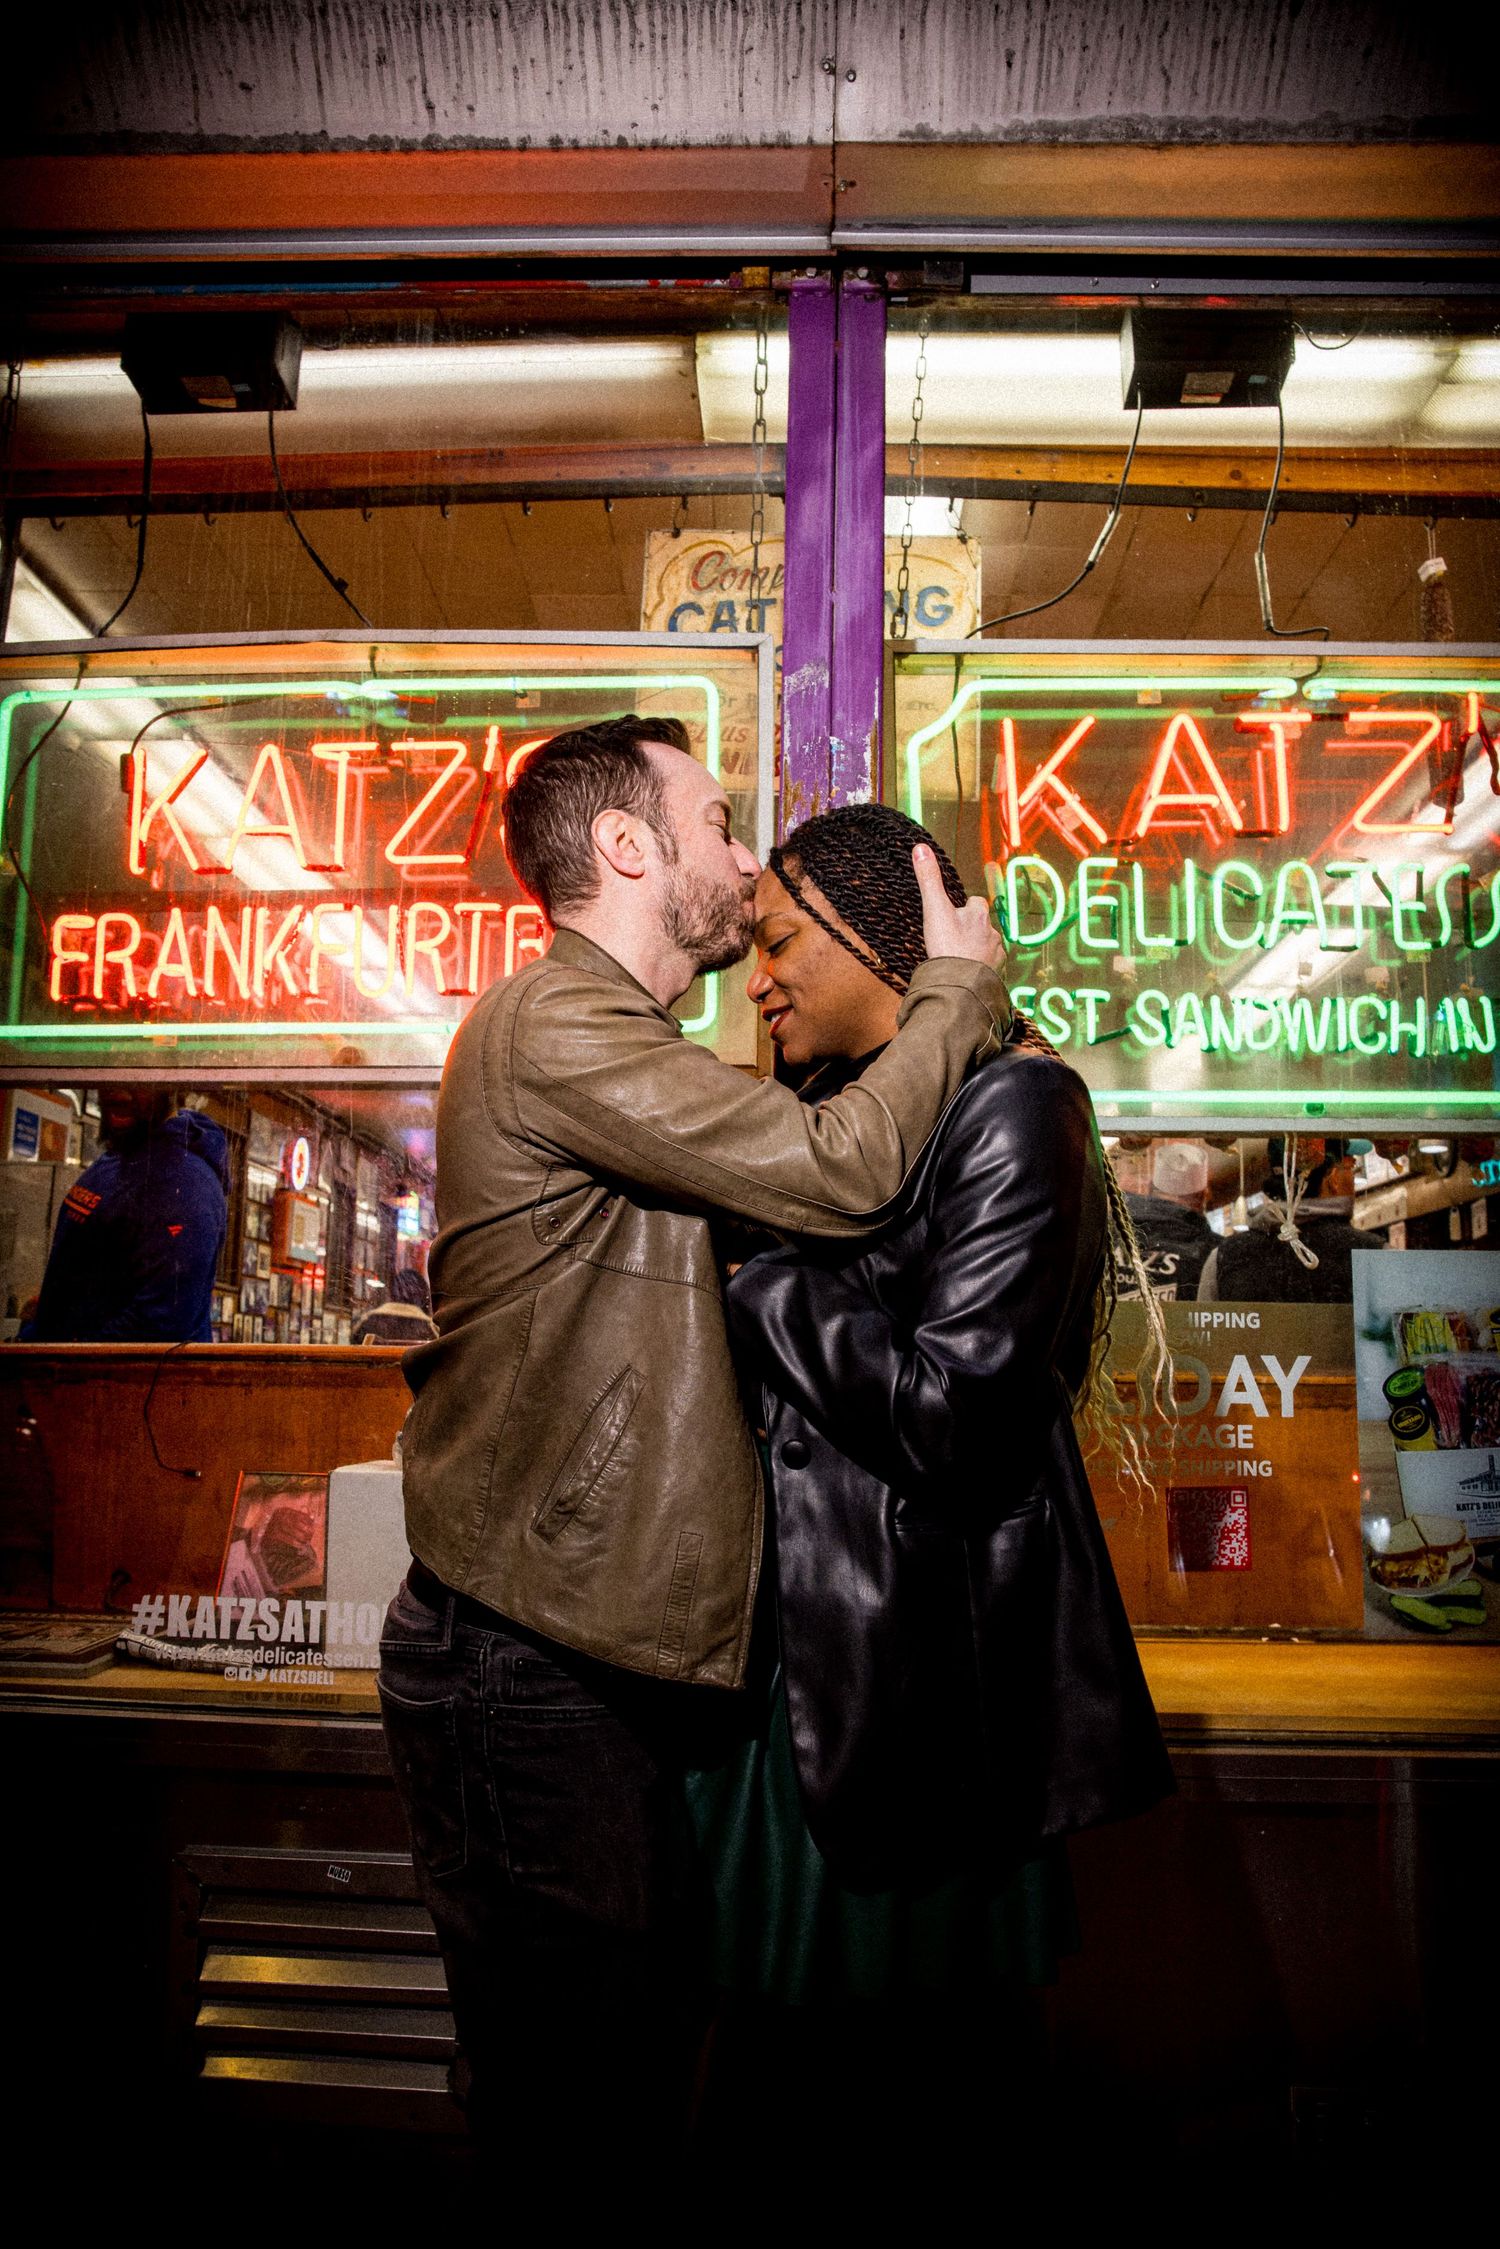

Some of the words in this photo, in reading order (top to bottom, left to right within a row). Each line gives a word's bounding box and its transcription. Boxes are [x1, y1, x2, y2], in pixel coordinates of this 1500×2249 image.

[1002, 690, 1500, 847] KATZ'
[1009, 986, 1111, 1046] EST
[1130, 989, 1427, 1058] SANDWICH
[131, 1594, 389, 1645] #KATZSATHO
[269, 1670, 334, 1685] KATZSDELI
